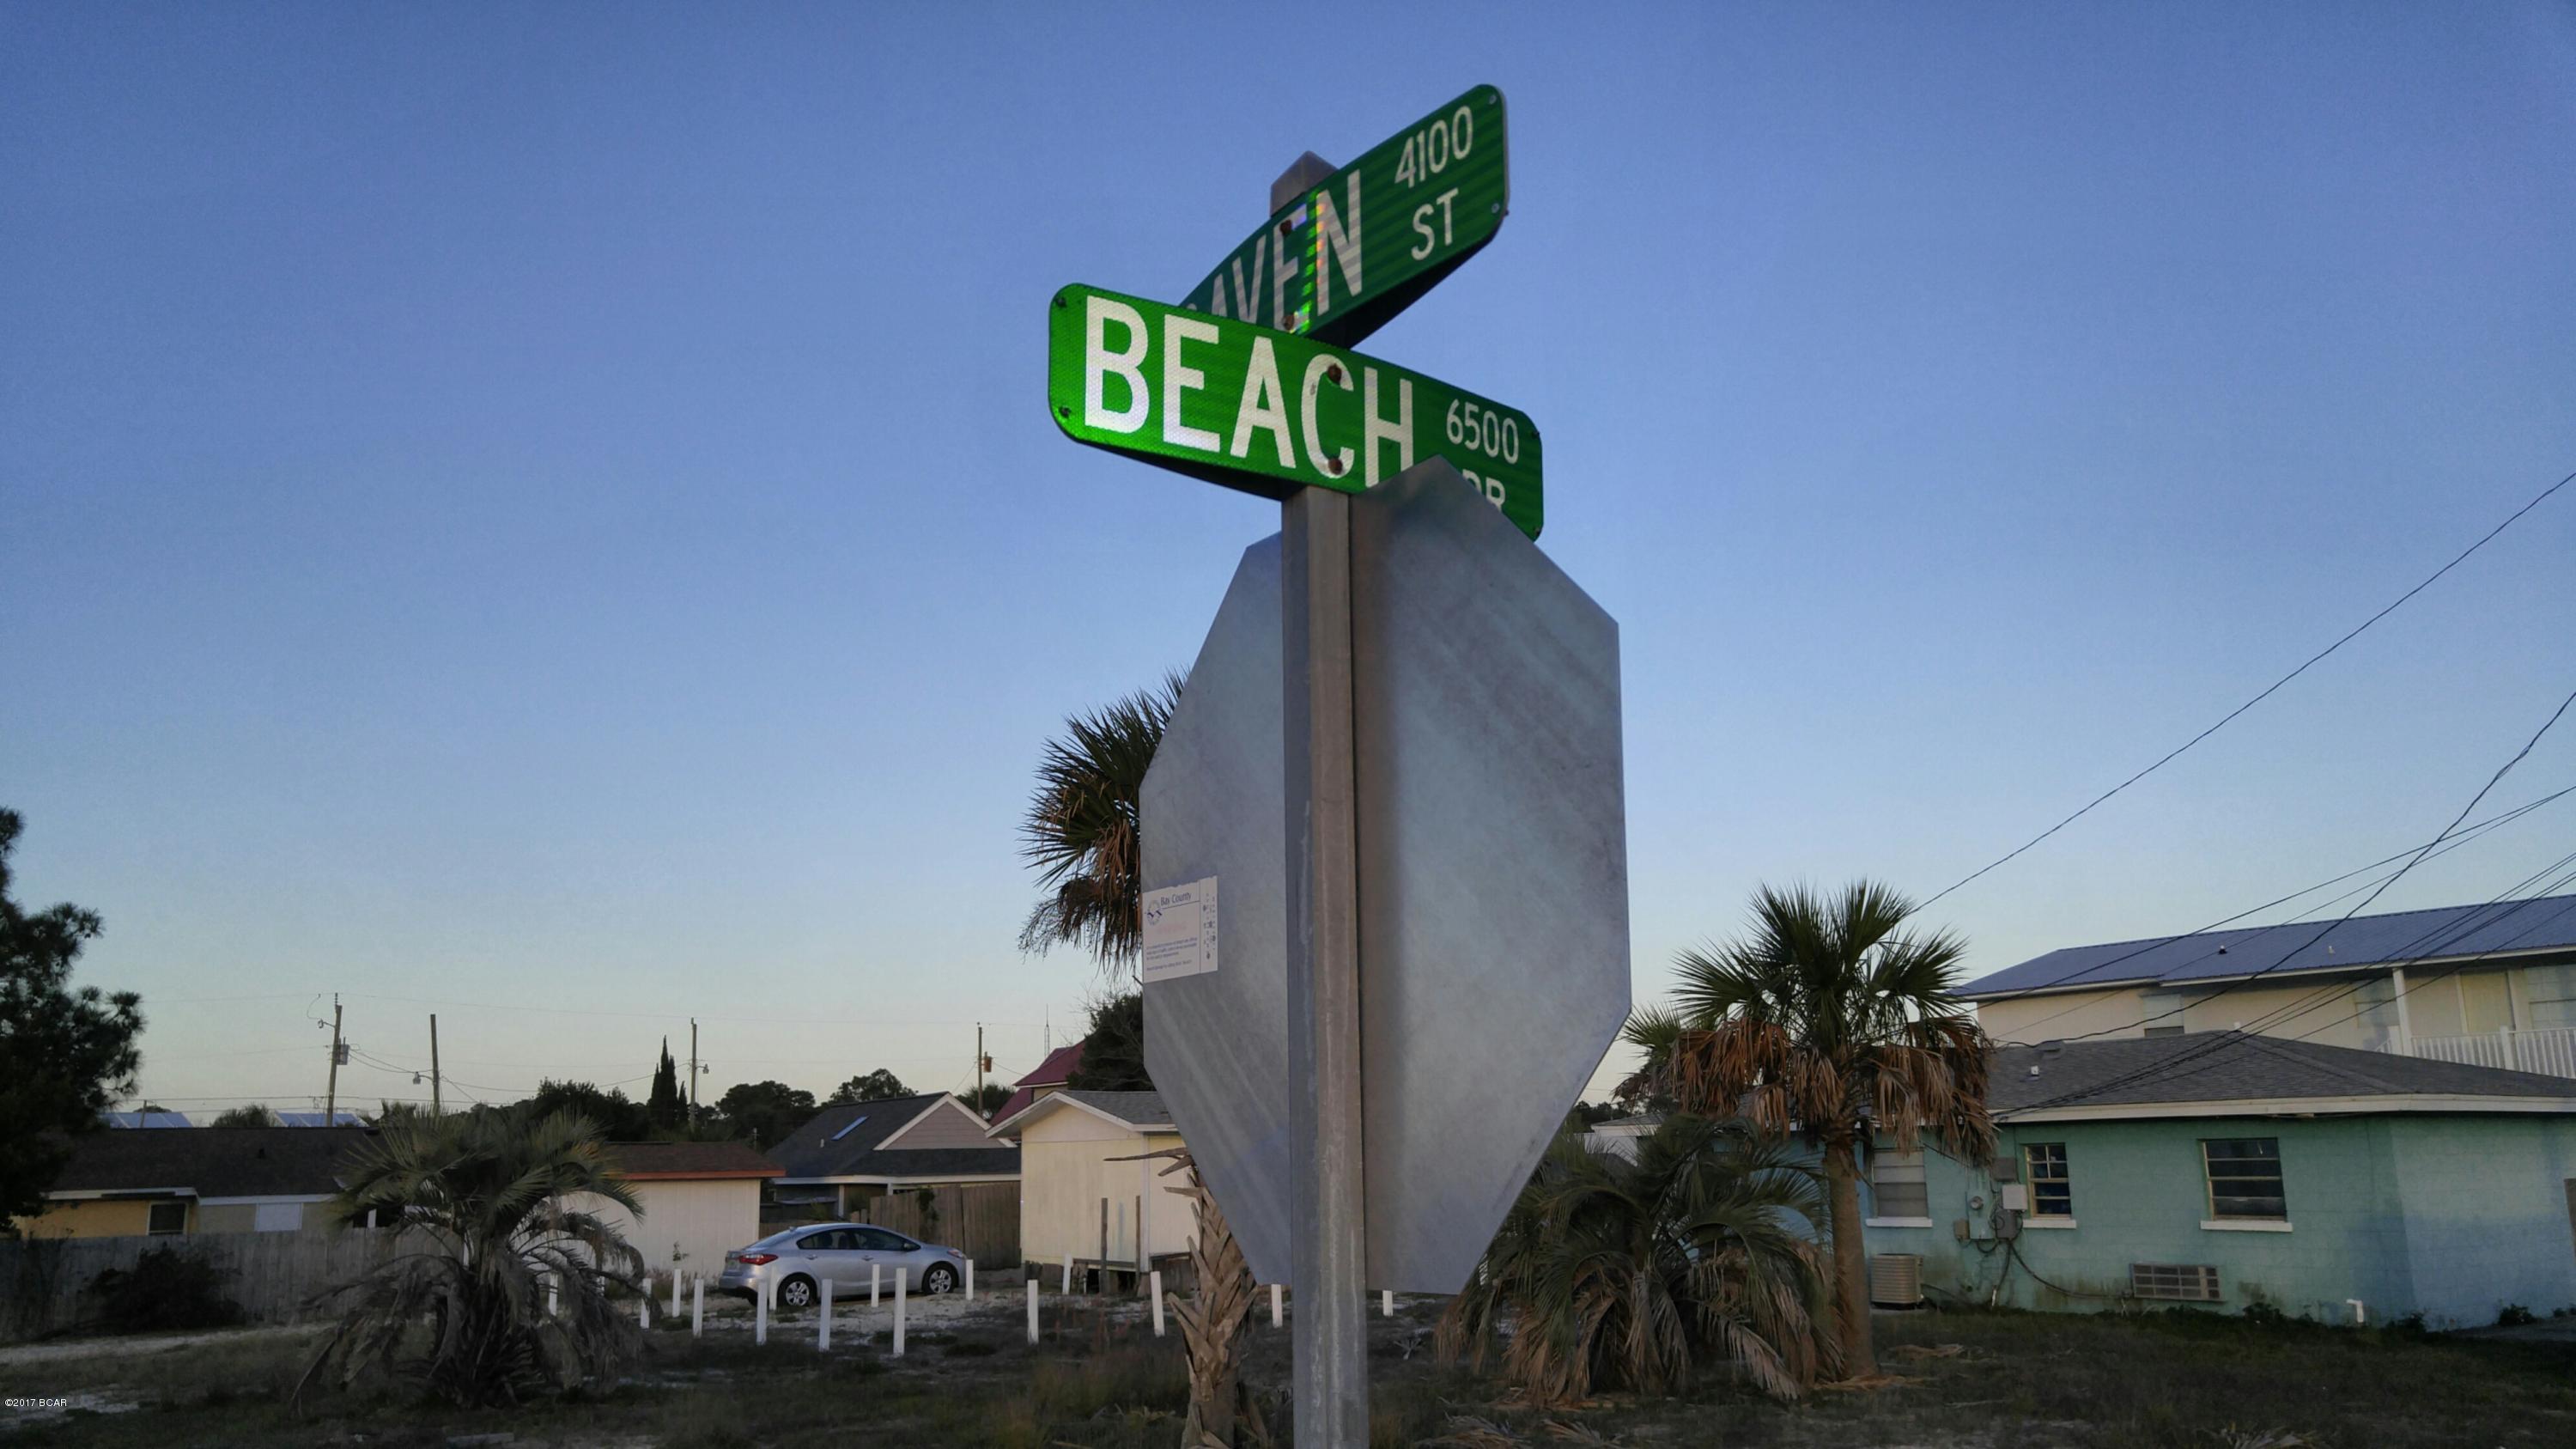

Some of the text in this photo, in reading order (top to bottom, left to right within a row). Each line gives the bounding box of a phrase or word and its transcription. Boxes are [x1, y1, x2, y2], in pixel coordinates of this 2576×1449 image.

[1394, 106, 1473, 189] 4100
[1186, 169, 1459, 333] VEN ST
[1084, 295, 1414, 488] BEACH
[1446, 399, 1519, 465] 6500
